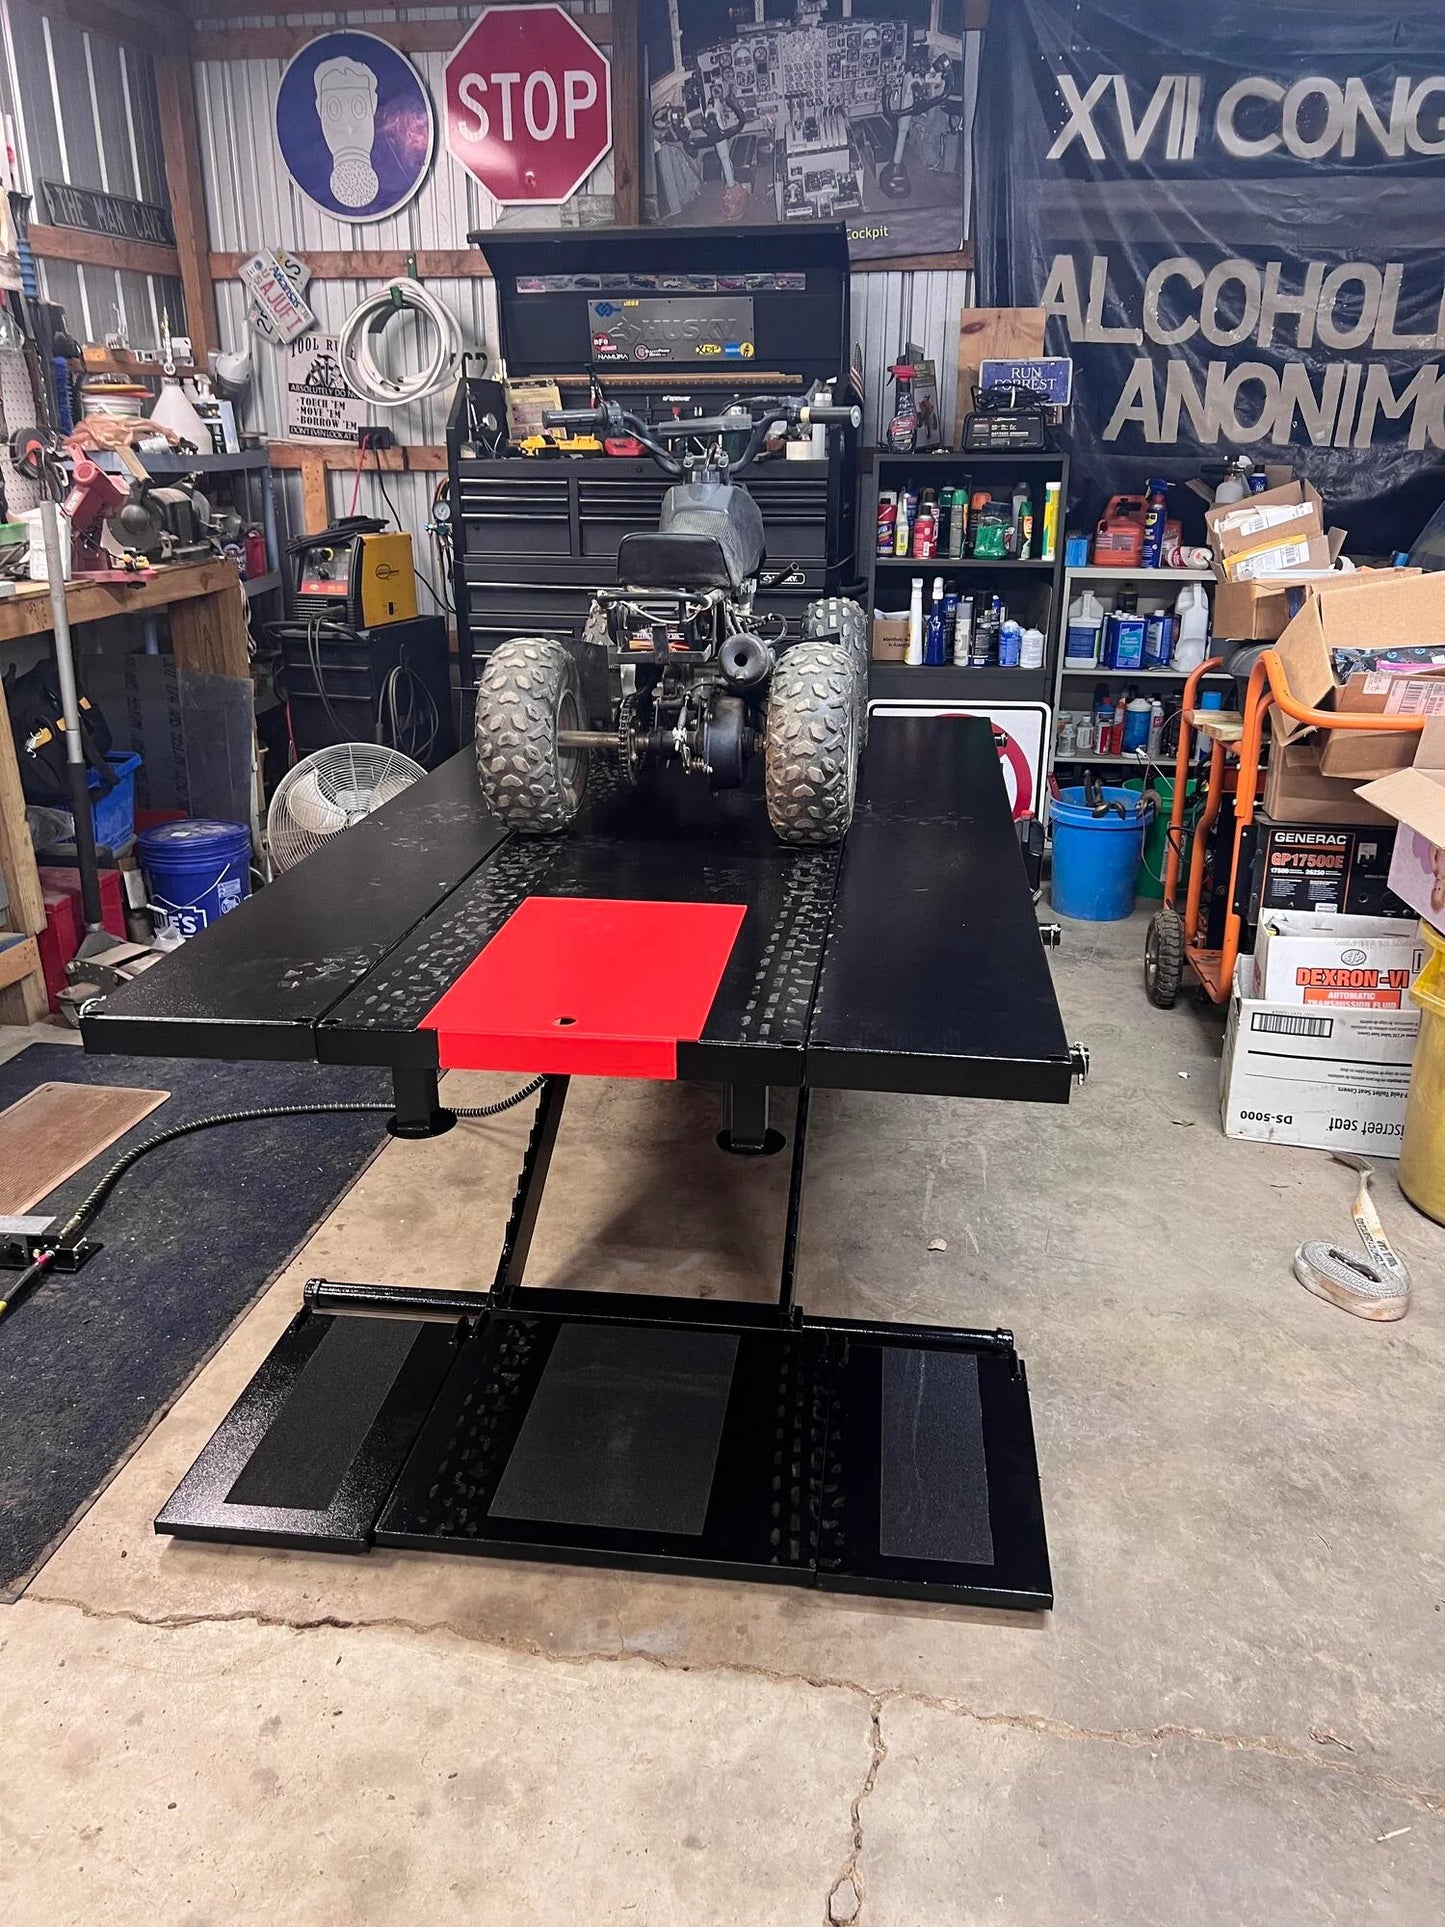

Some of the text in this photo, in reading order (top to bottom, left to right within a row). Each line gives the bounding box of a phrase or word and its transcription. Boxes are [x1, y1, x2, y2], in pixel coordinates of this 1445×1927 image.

[457, 70, 598, 142] STOP
[1216, 76, 1445, 159] CONG
[54, 186, 166, 243] THE MAN CAVE
[846, 225, 889, 241] Cockpit
[270, 265, 301, 308] Arkansas
[290, 337, 320, 358] TOOL
[597, 353, 629, 361] NAMURA
[1011, 367, 1043, 379] RUN
[291, 385, 333, 396] ABSOLUTELY
[334, 389, 346, 397] DO
[994, 378, 1056, 391] FORREST
[300, 397, 346, 411] TOUCH 'EM
[1102, 358, 1445, 450] ANONIM
[300, 406, 341, 420] MOVE 'EM
[300, 416, 357, 431] BORROW 'EM
[1274, 832, 1347, 845] GENERAC
[1271, 852, 1345, 869] GP17500E
[1344, 951, 1364, 963] STP
[1327, 991, 1376, 1000] AUTOMATIC
[1338, 1086, 1358, 1095] Covers
[1358, 1087, 1372, 1096] Seat
[1372, 1089, 1389, 1098] Toilet
[1240, 1110, 1293, 1125] DS-5000
[1325, 1117, 1405, 1141] iscreet seat
